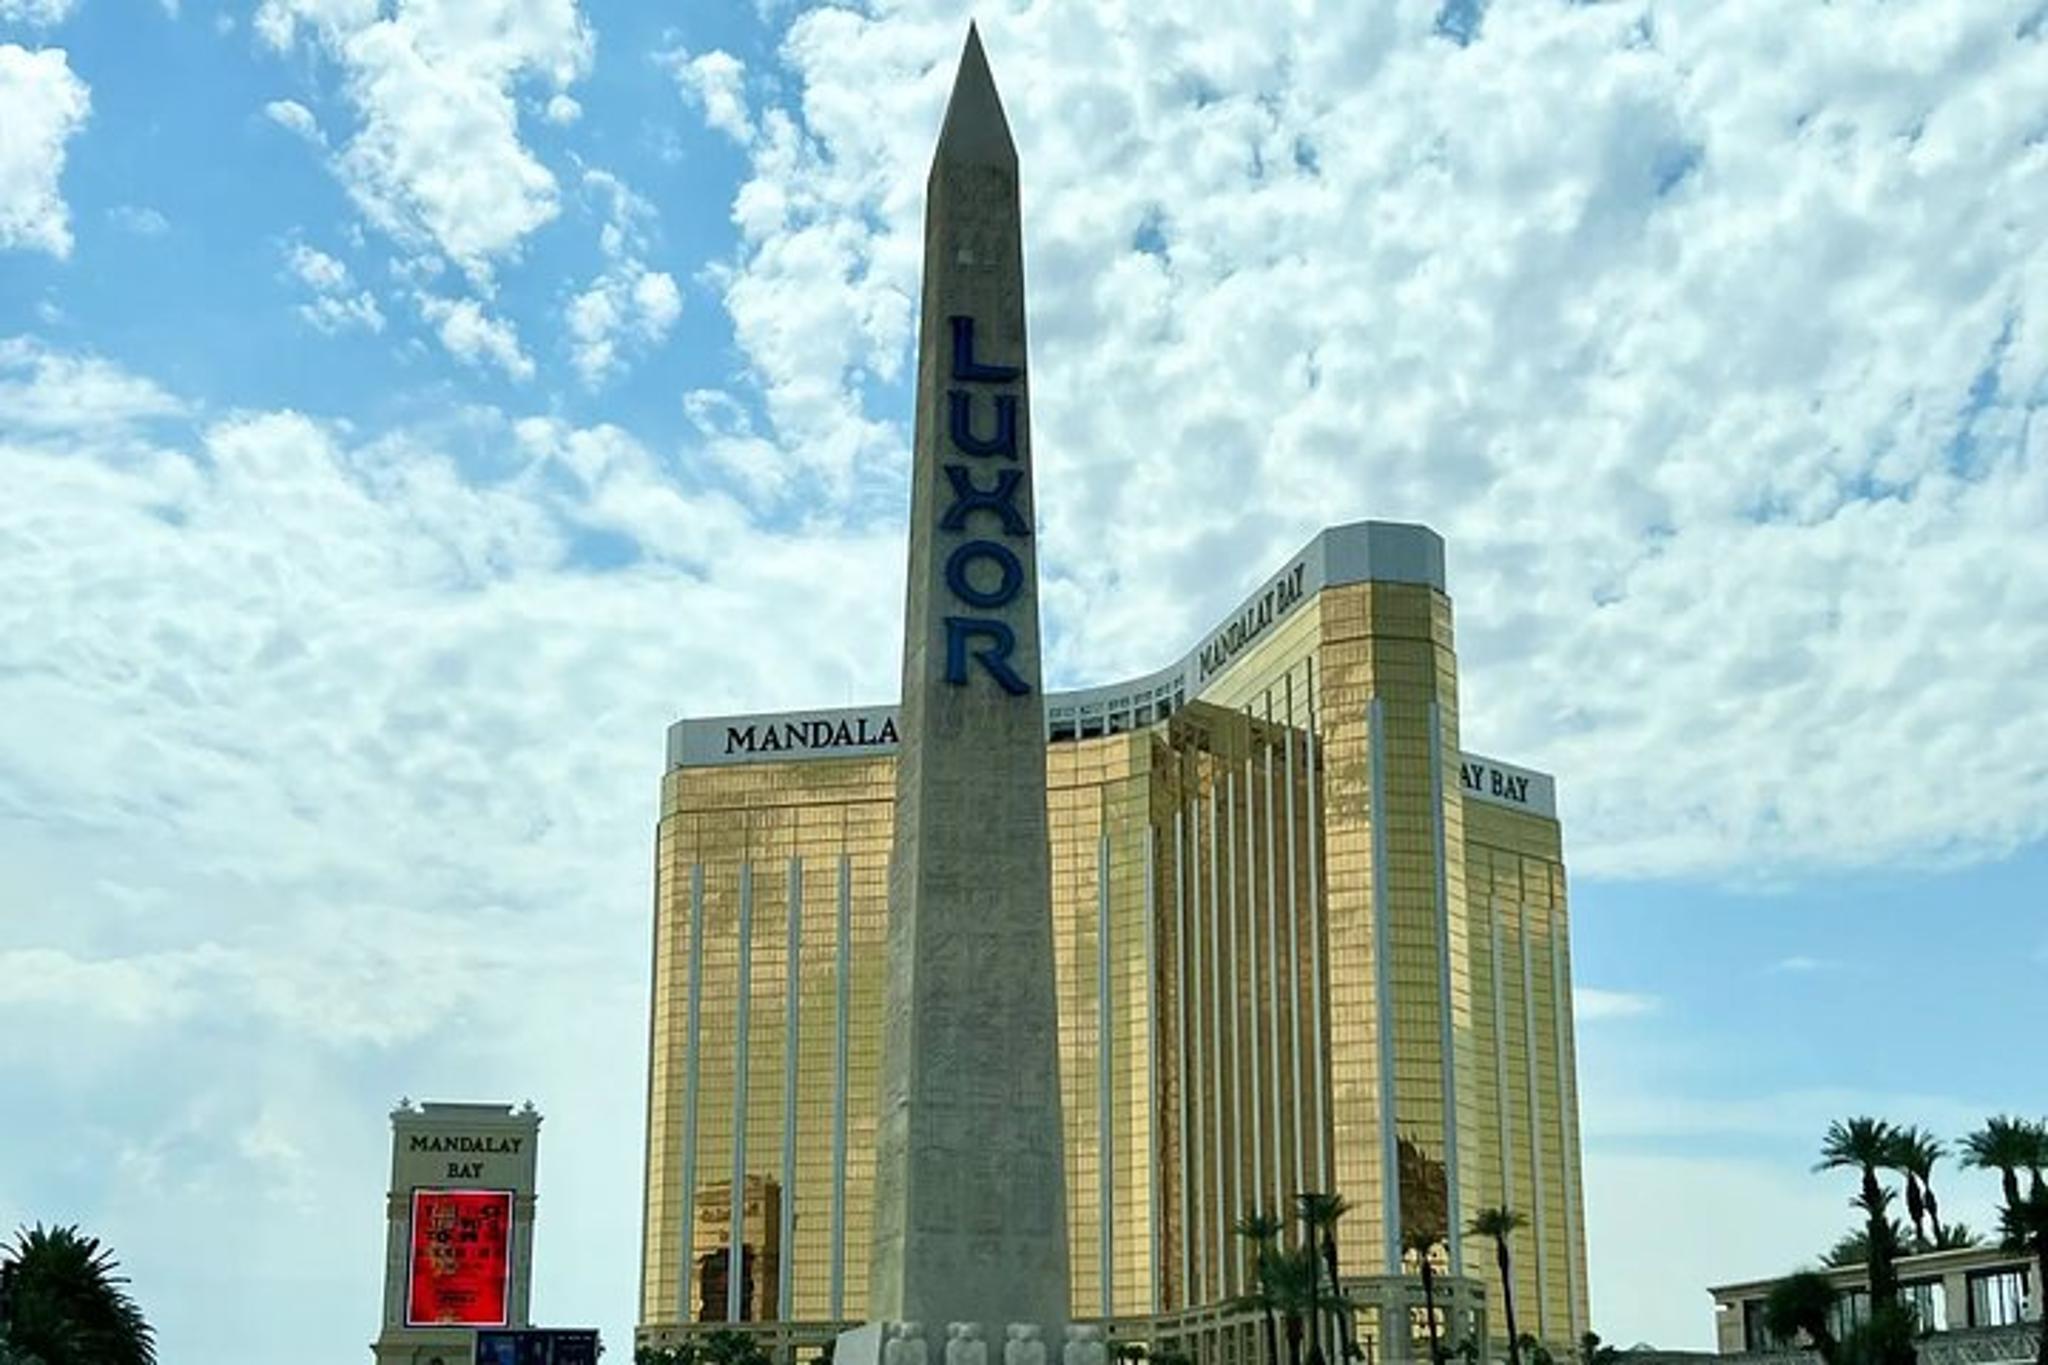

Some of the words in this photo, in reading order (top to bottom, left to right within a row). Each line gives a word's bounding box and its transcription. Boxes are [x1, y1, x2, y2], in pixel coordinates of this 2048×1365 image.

[939, 315, 1031, 696] LUXOR
[1199, 590, 1274, 682] MANDALAY
[1277, 562, 1305, 614] BAY
[724, 716, 899, 754] MANDALA
[1460, 762, 1484, 791] AY
[1490, 769, 1528, 802] BAY
[410, 1135, 522, 1153] MANDALAY
[447, 1162, 484, 1178] BAY
